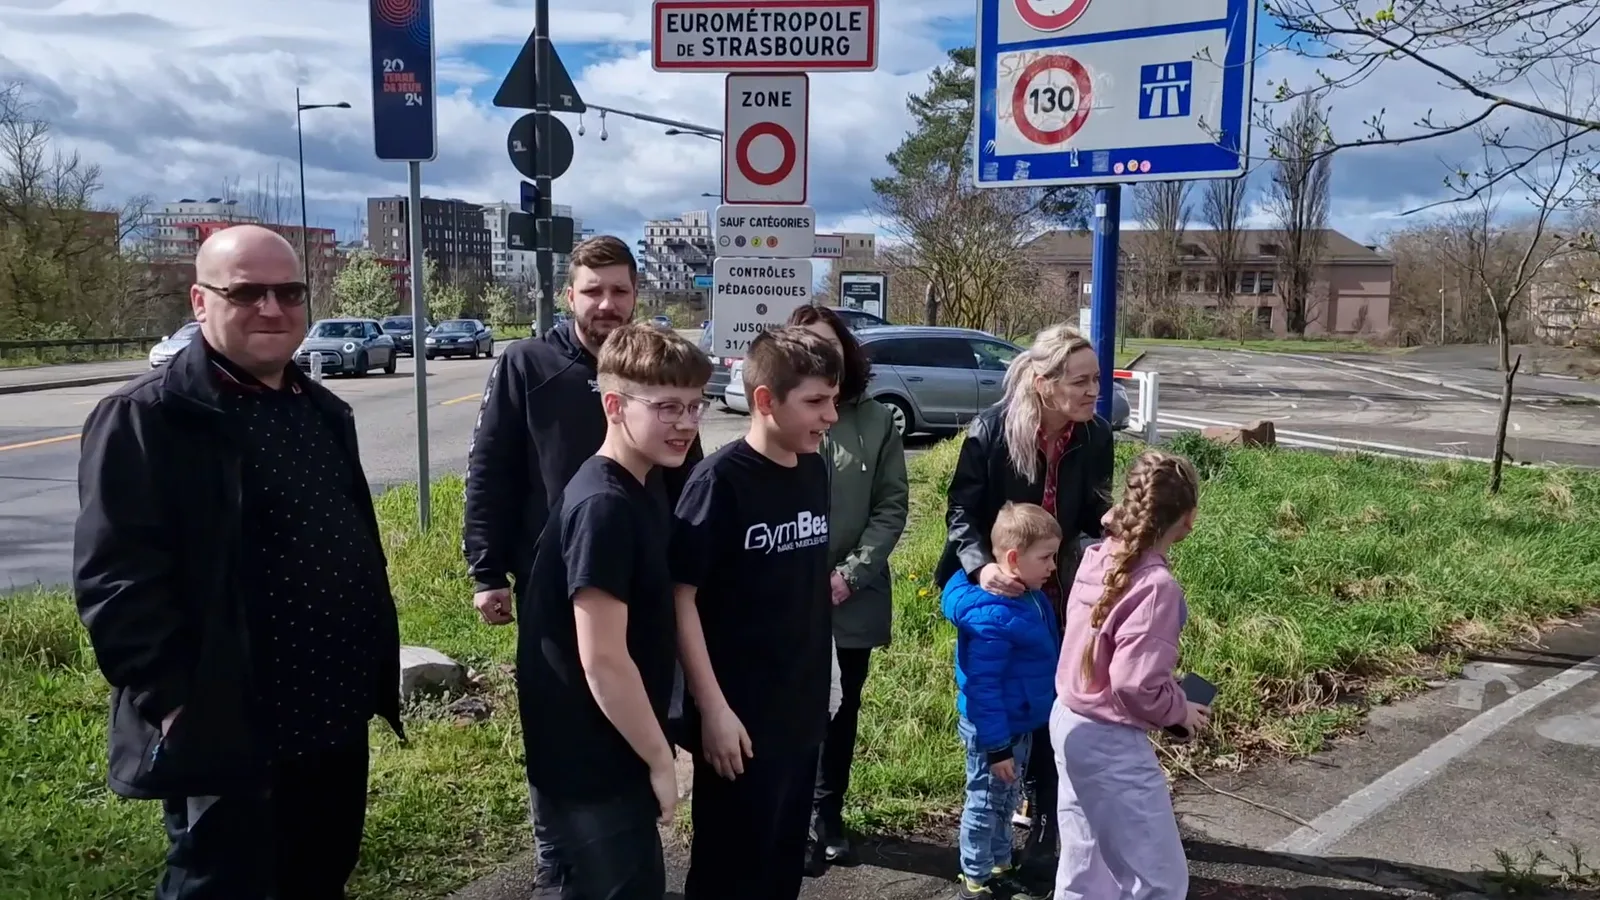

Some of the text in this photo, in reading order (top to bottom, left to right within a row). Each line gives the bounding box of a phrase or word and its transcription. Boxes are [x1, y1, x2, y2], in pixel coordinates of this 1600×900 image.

[667, 9, 861, 33] EUROMÉTROPOLE
[677, 36, 850, 57] DE STRASBOURG
[383, 58, 404, 72] 20
[405, 93, 423, 106] 24
[742, 91, 792, 107] ZONE
[1029, 86, 1075, 115] 130
[720, 215, 810, 228] SAUF CATÉGORIES
[729, 266, 796, 278] CONTRÔLES
[718, 284, 807, 297] PÉDAGOGIQUES
